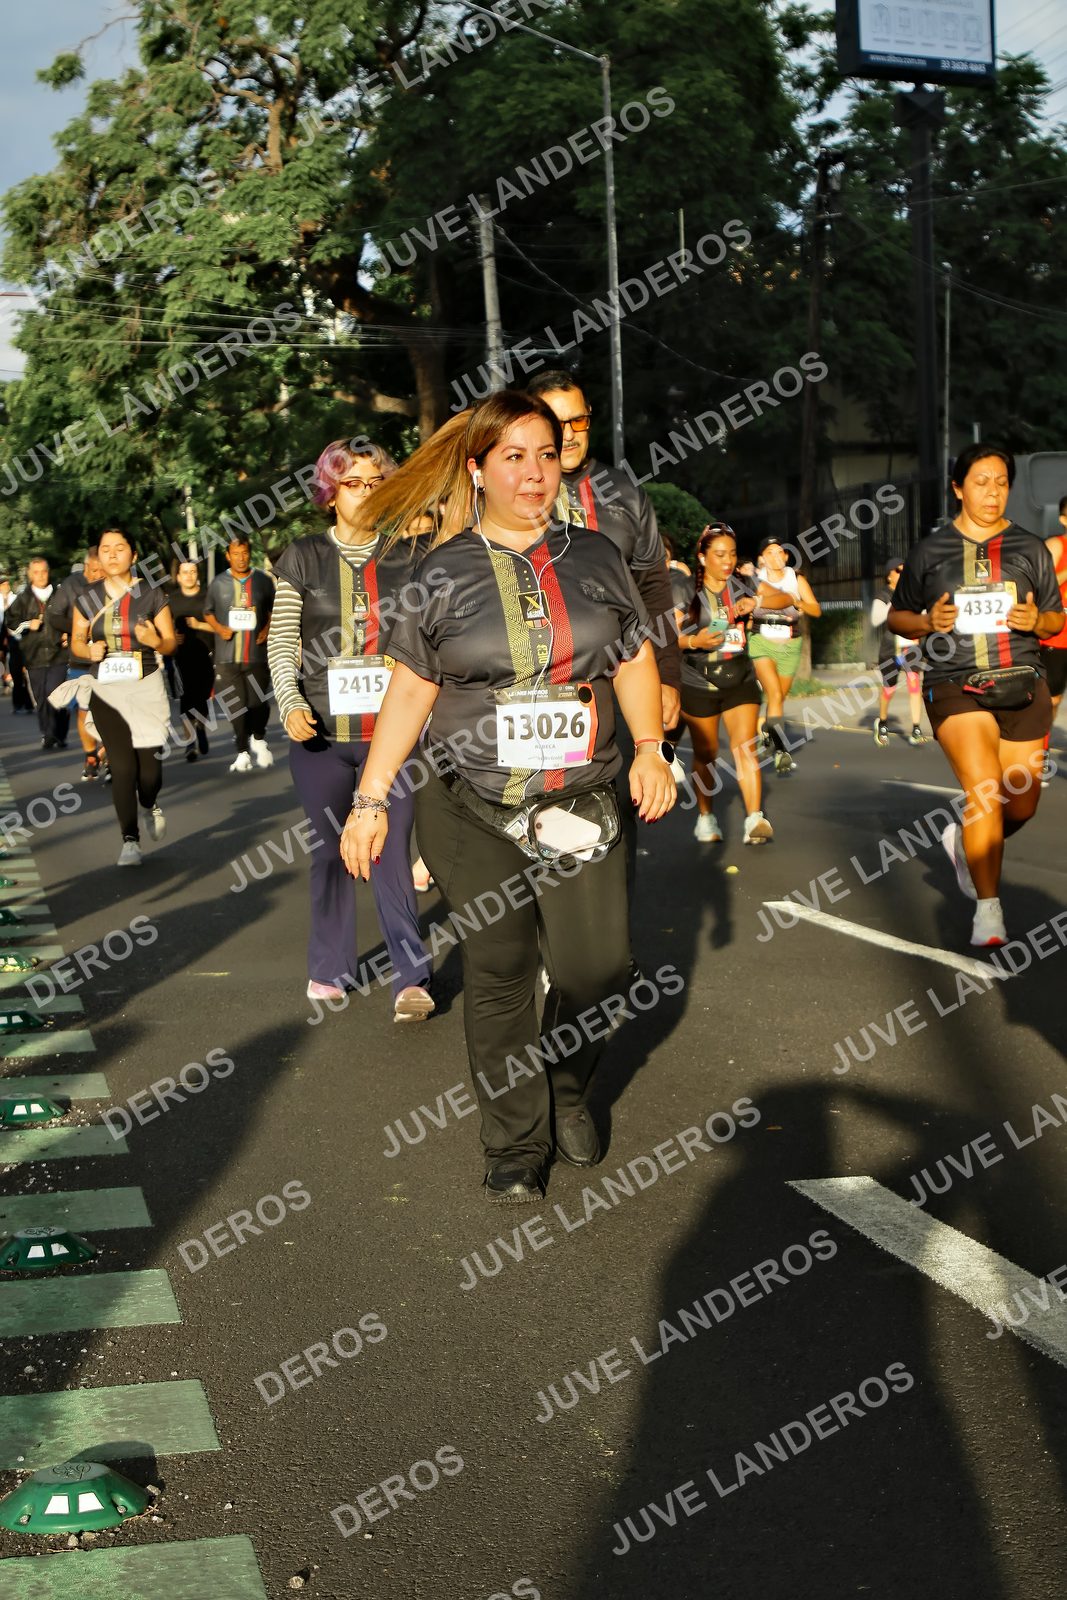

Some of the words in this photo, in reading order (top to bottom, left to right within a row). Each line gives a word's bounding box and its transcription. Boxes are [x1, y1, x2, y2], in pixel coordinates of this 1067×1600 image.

[963, 599, 1003, 616] 4332
[104, 662, 133, 674] 3464
[338, 674, 384, 694] 2415
[503, 712, 586, 740] 13026
